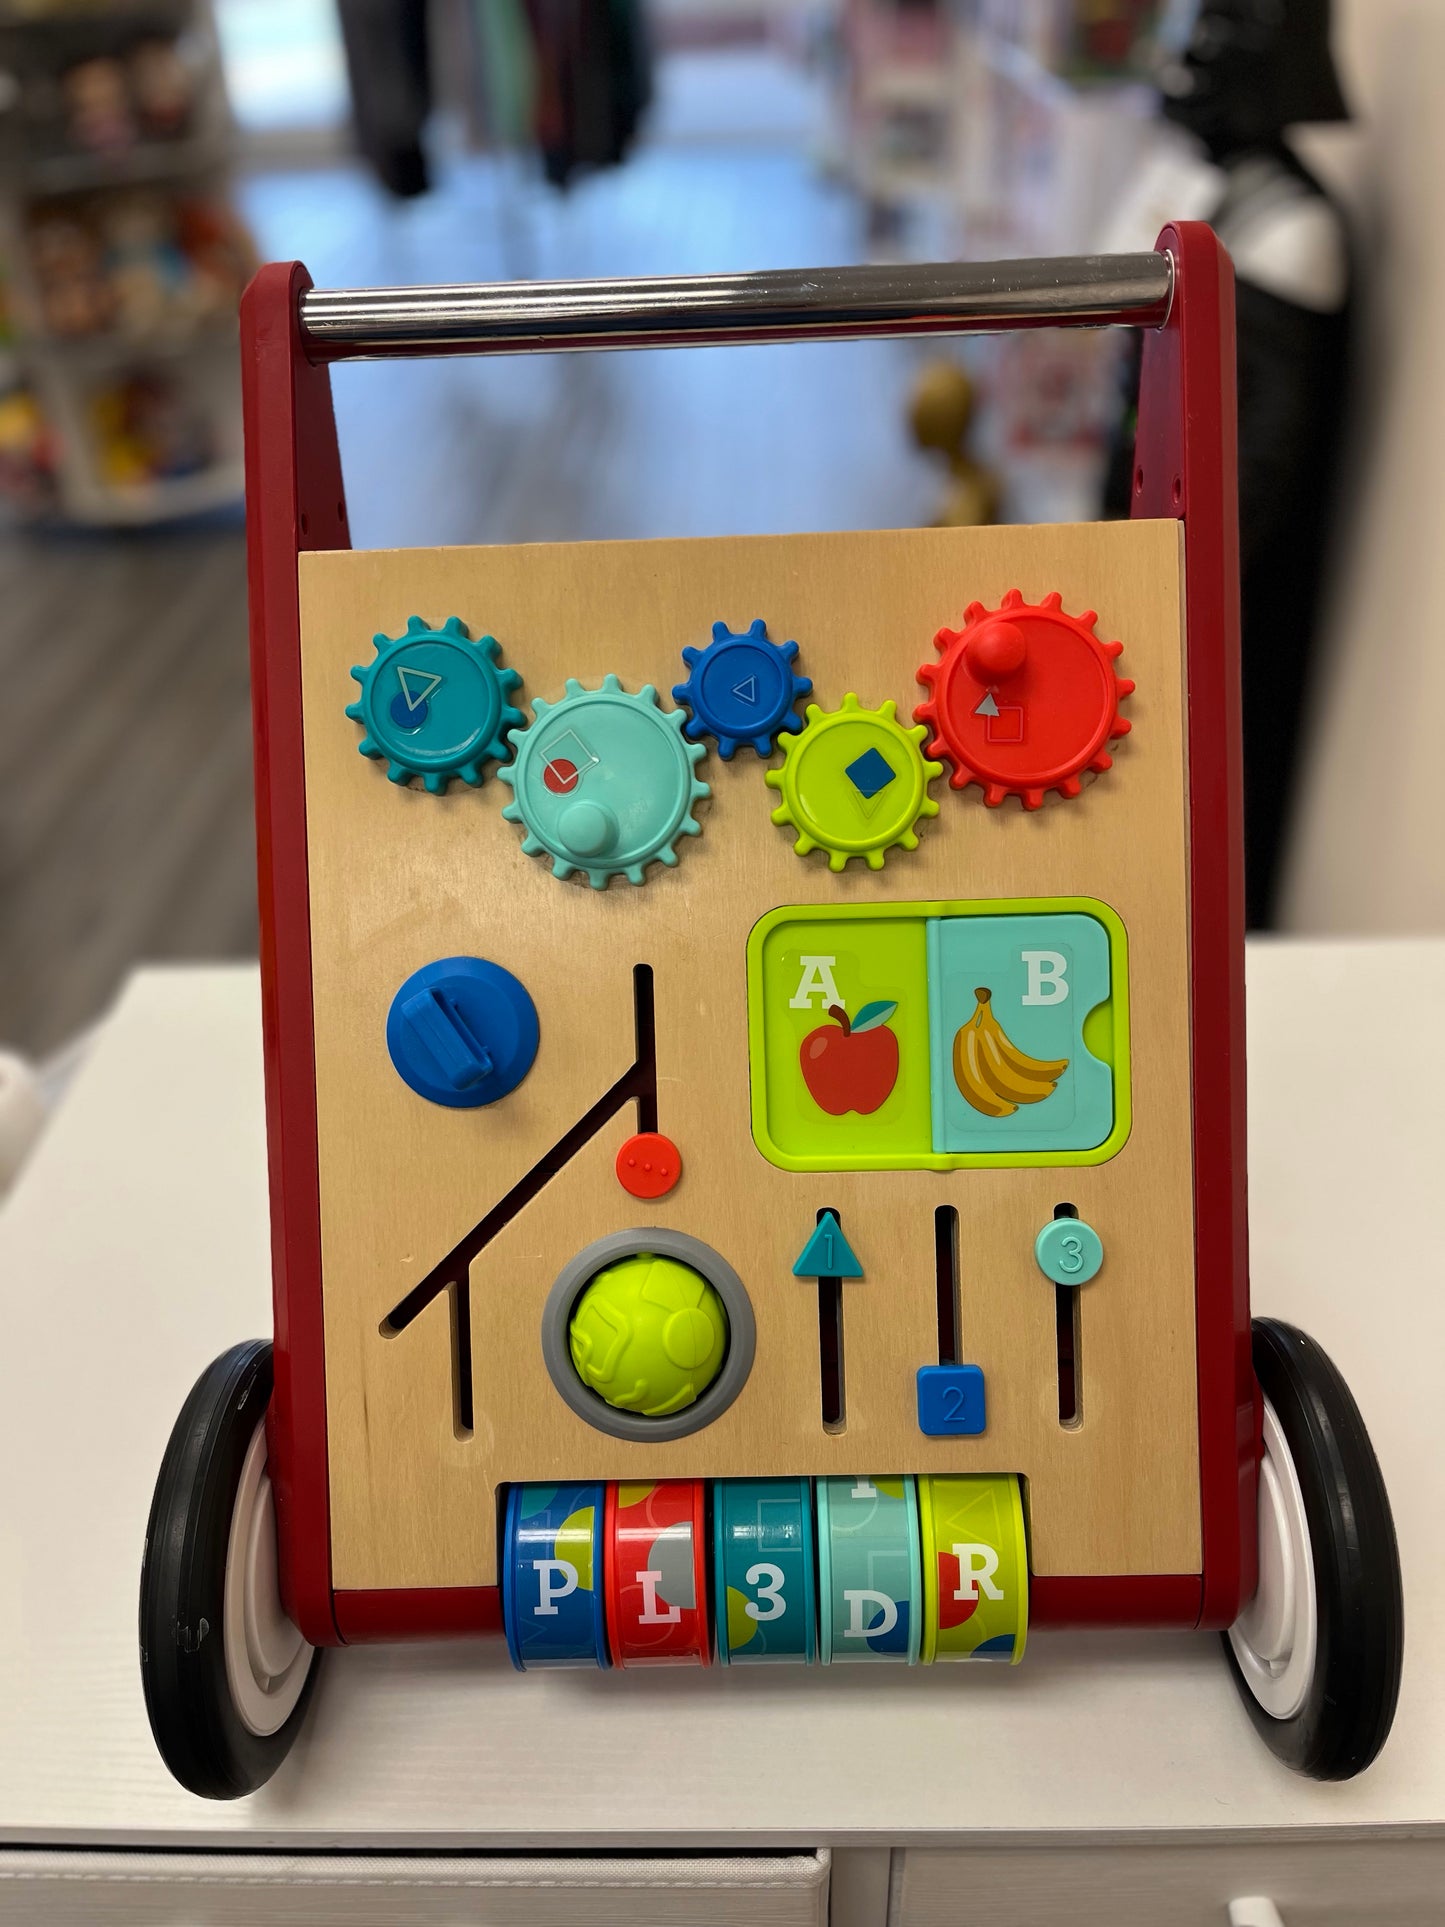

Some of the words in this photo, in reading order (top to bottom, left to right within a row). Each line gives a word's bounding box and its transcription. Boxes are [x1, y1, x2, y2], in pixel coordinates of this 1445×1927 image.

[789, 955, 845, 1010] A
[1021, 950, 1070, 1006] B
[823, 1233, 834, 1270] 1
[1058, 1236, 1085, 1274] 3
[941, 1385, 966, 1423] 2
[533, 1559, 579, 1615] P
[635, 1569, 681, 1624] L
[744, 1562, 787, 1621] 3
[843, 1589, 898, 1638] D
[952, 1542, 1005, 1601] R
